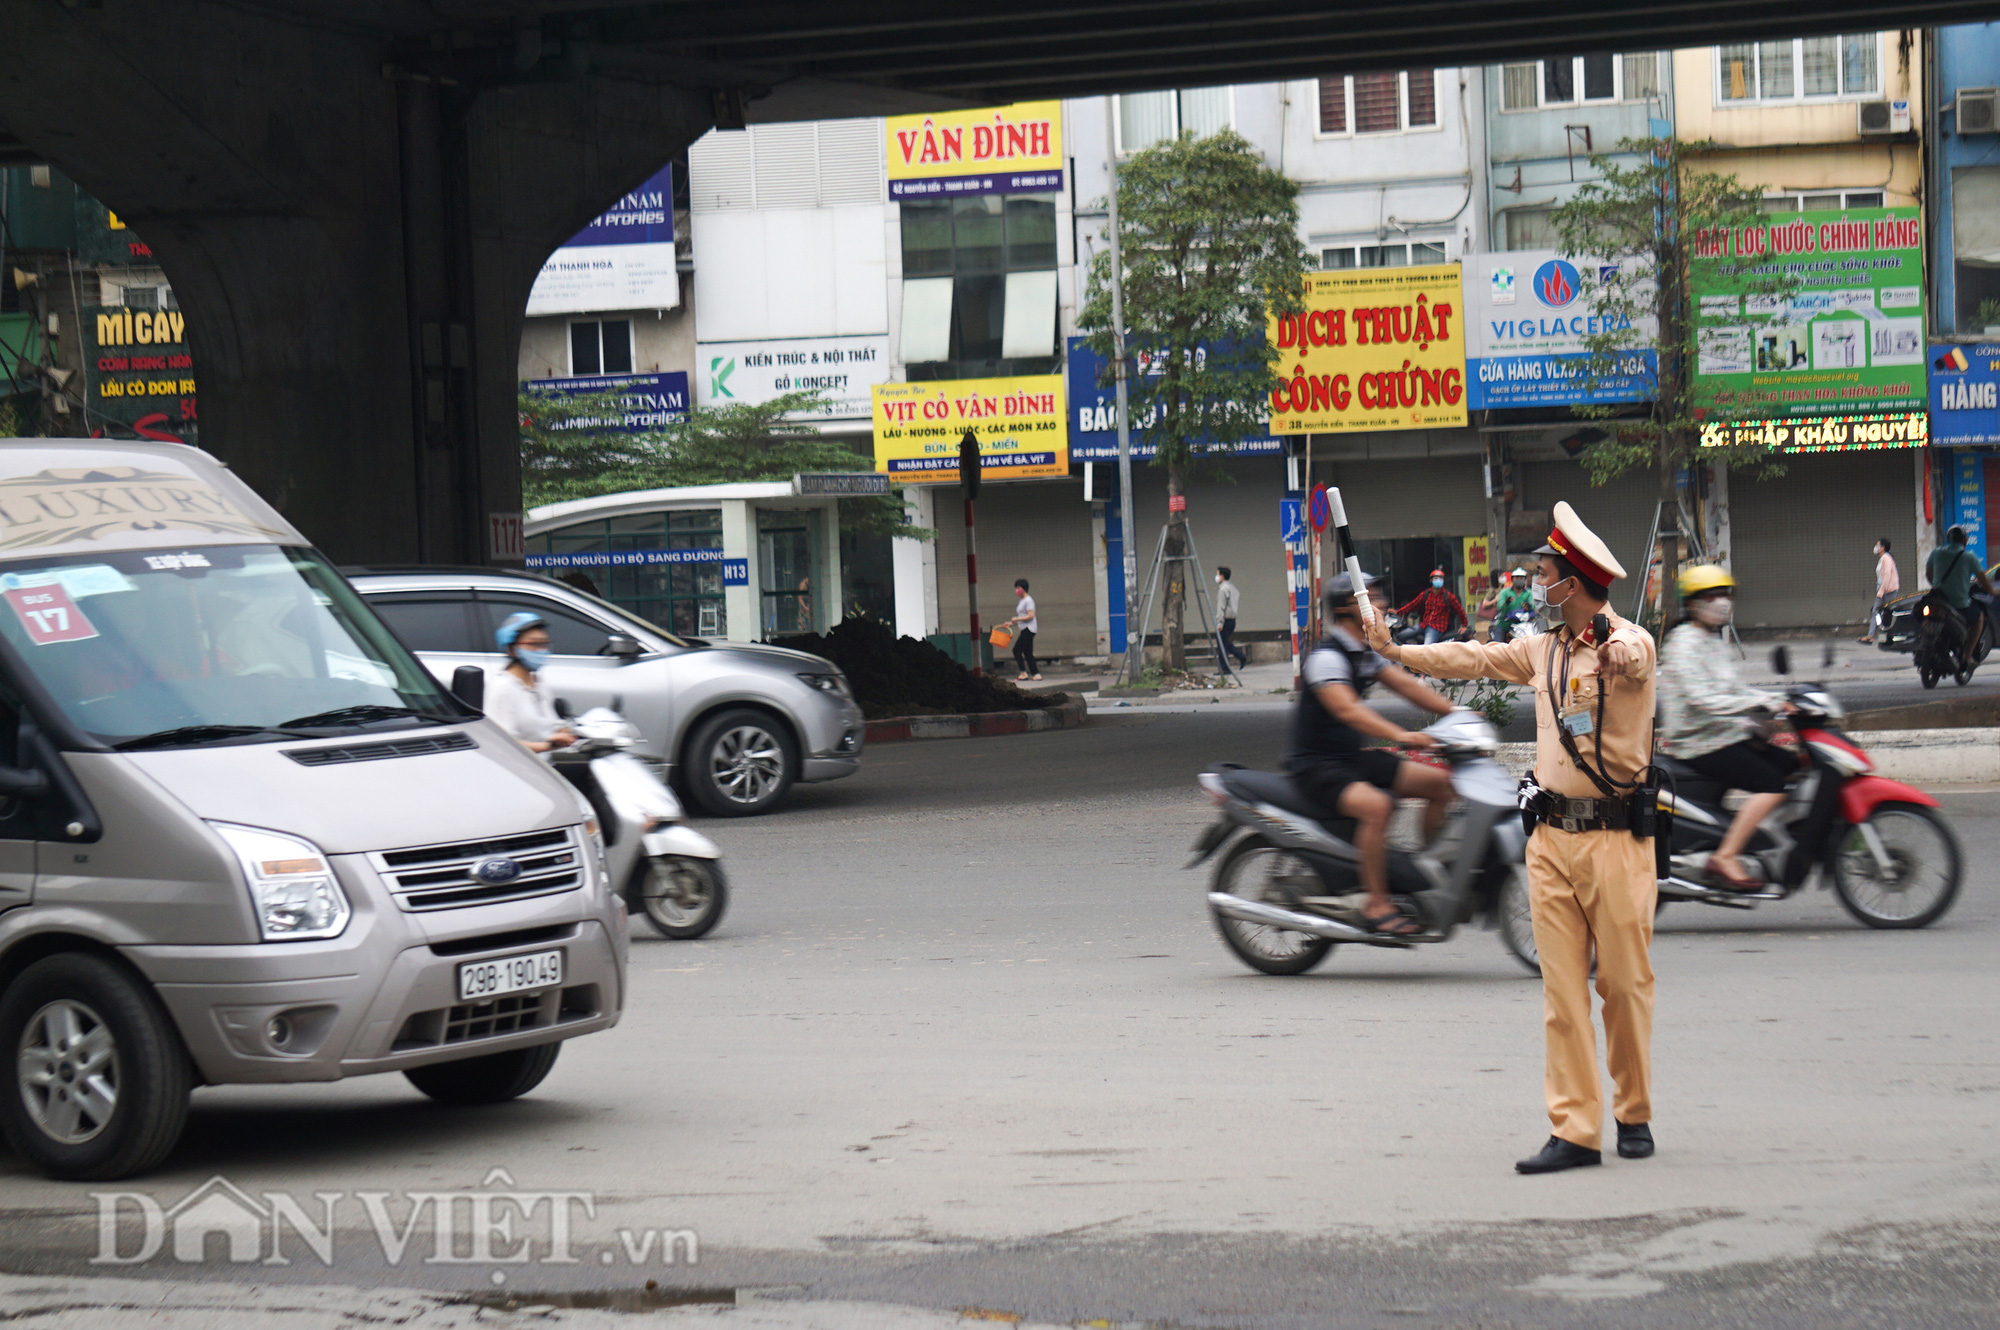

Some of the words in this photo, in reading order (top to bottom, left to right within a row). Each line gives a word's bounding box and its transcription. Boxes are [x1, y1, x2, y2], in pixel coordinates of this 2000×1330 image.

[897, 119, 963, 165] VÂN
[972, 114, 1050, 160] ĐÌNH
[1694, 222, 1730, 259] MÁY
[1735, 226, 1765, 259] LỌC
[1770, 217, 1815, 254] NƯỚC
[1820, 214, 1870, 253] CHÍNH
[1874, 211, 1920, 250] HÃNG
[559, 260, 590, 272] THANH
[592, 260, 613, 270] NGA
[1782, 261, 1805, 274] CHO
[1808, 260, 1837, 276] CUỘC
[1277, 309, 1347, 357] DỊCH
[1353, 293, 1453, 351] THUẬT
[1491, 312, 1632, 340] VIGLACERA
[745, 350, 773, 368] KIẾN
[776, 350, 807, 366] TRÚC
[811, 352, 820, 364] &
[824, 350, 844, 367] NỘI
[848, 345, 877, 362] THẤT
[775, 373, 791, 391] GỖ
[794, 374, 849, 390] KONCEPT
[1479, 358, 1505, 384] CỬA
[1508, 357, 1542, 382] HÀNG
[1272, 364, 1352, 413] CÔNG
[1358, 359, 1463, 410] CHỨNG
[1781, 388, 1811, 402] THAN
[1840, 385, 1881, 399] KHÔNG
[1941, 377, 1997, 411] HÀNG
[883, 401, 917, 428] VỊT
[923, 392, 949, 419] CỎ
[955, 392, 998, 419] VÂN
[1004, 389, 1055, 417] ĐÌNH
[909, 424, 947, 438] NƯỚNG
[987, 421, 1006, 433] CÁC
[1009, 421, 1032, 433] MÓN
[1035, 420, 1057, 432] XÀO
[1794, 416, 1848, 445] KHẨU
[924, 442, 947, 454] BÚN
[992, 438, 1019, 450] MIẾN
[897, 458, 923, 473] NHẬN
[924, 458, 943, 471] ĐẶT
[1030, 454, 1046, 466] VỊT
[0, 486, 239, 528] LUXURY
[545, 556, 570, 567] CHO
[572, 552, 610, 566] NGƯỜI
[613, 554, 626, 565] ĐI
[628, 552, 645, 566] BỘ
[648, 552, 681, 563] SANG
[683, 549, 725, 562] ĐƯỜNG
[724, 564, 747, 580] H13
[21, 593, 54, 605] BUS
[24, 607, 70, 633] 17
